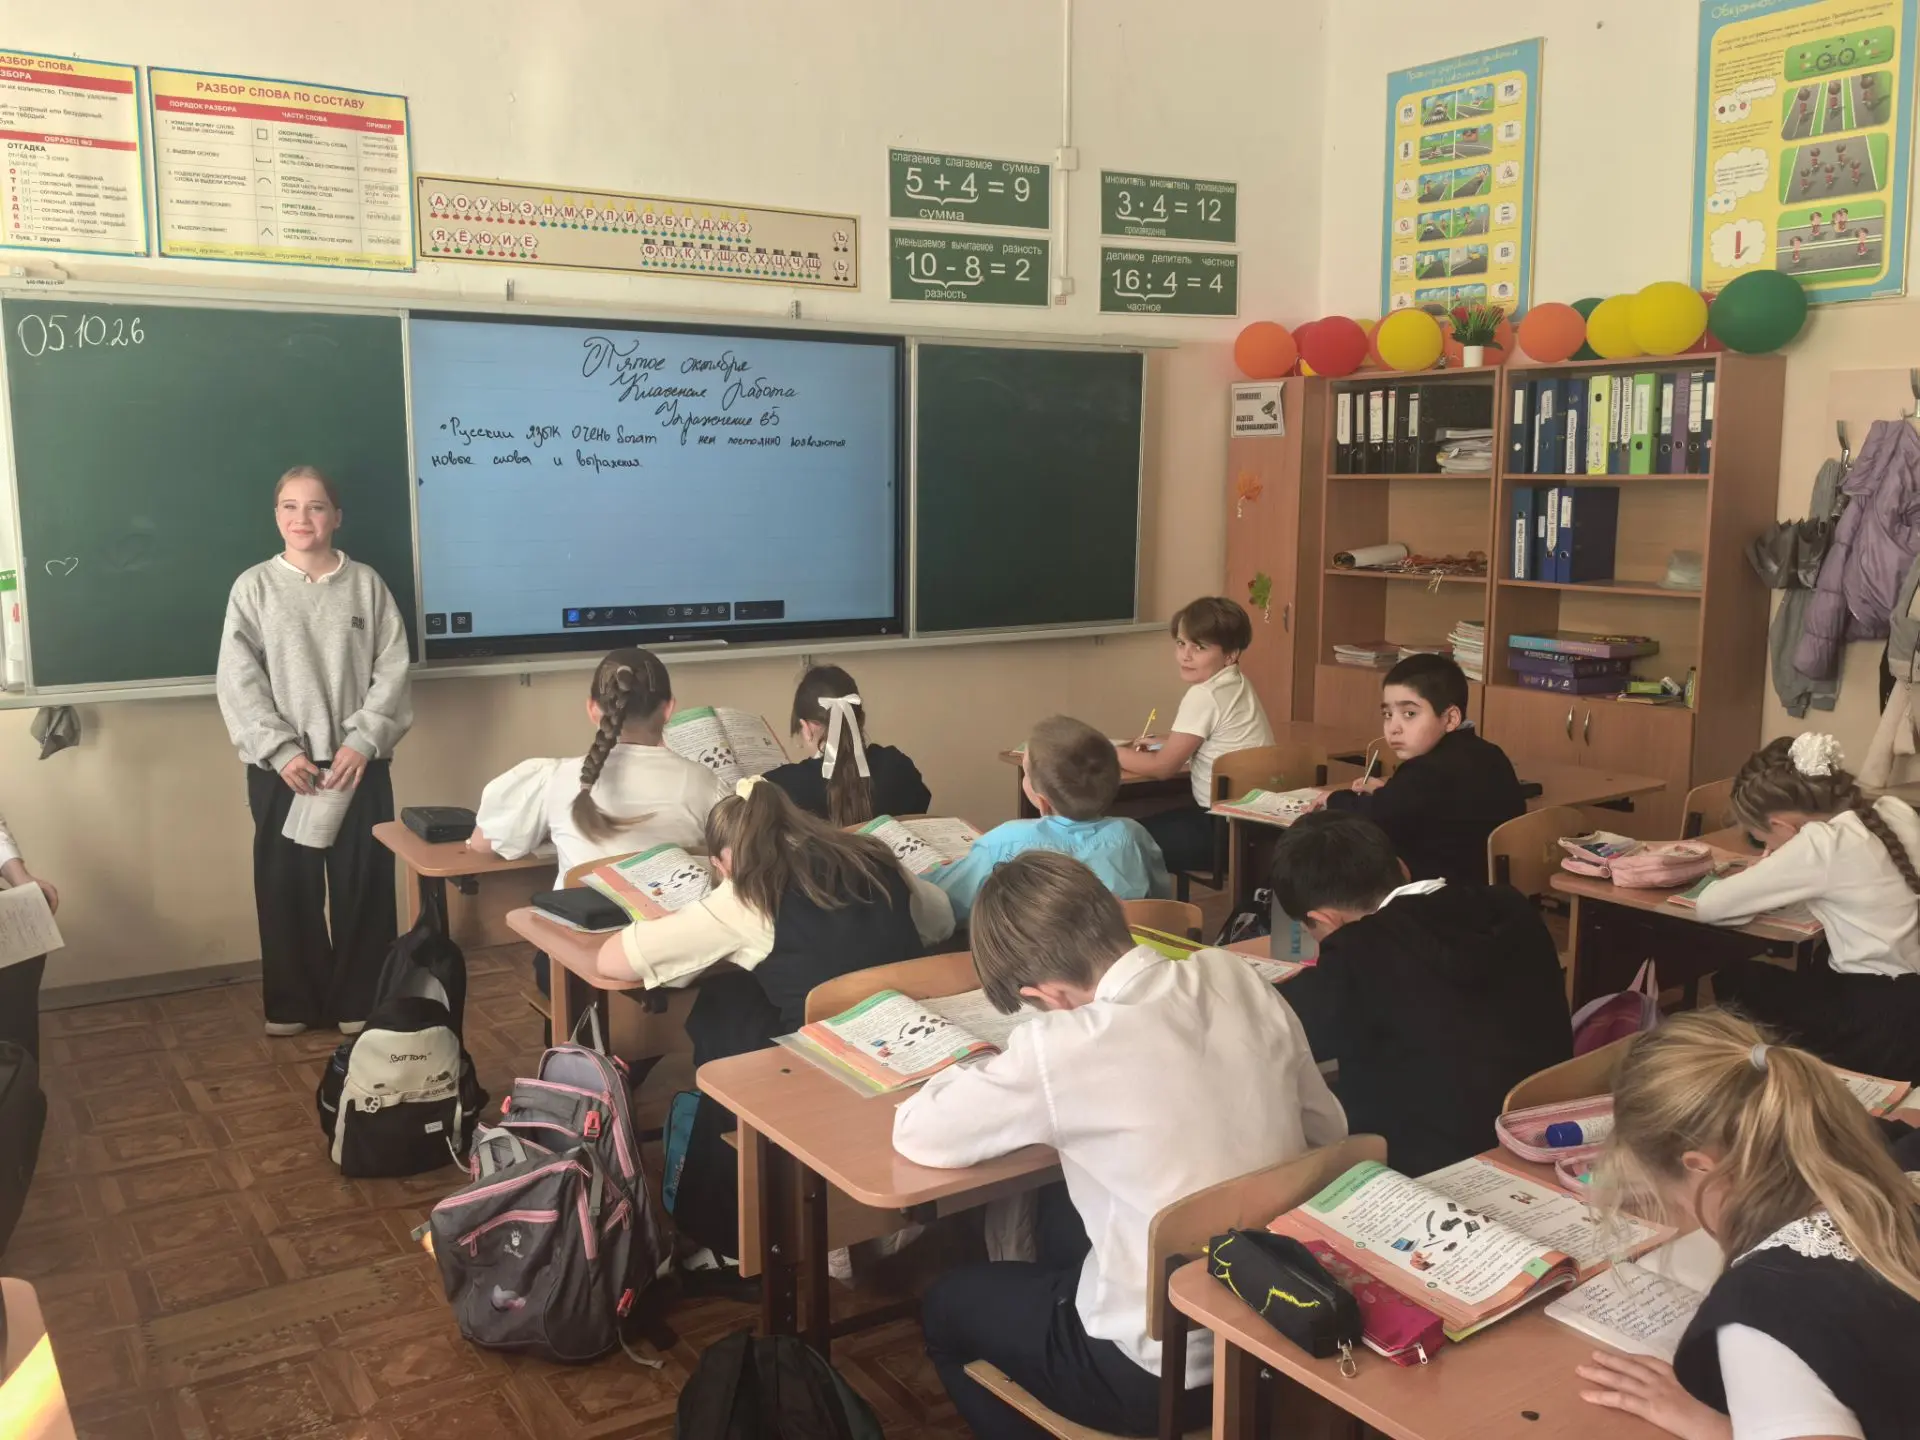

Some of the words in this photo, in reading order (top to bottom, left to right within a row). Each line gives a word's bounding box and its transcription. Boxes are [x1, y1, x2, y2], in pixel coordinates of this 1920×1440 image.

[38, 60, 74, 71] СЛОВА
[196, 81, 246, 97] РАЗБОР
[249, 87, 291, 101] СЛОВА
[294, 91, 310, 102] ПО
[313, 94, 365, 110] СОСТАВУ
[169, 100, 204, 110] ПОРЯДОК
[204, 104, 238, 113] РАЗБОРА
[281, 111, 303, 120] ЧАСТИ
[303, 114, 328, 123] СЛОВА
[366, 121, 392, 131] ПРИМЕР
[8, 142, 46, 152] ОТГАДКА
[892, 152, 942, 167] слагаемое
[946, 159, 993, 171] слагаемое
[1003, 163, 1041, 175] сумма
[906, 167, 923, 193] 5
[934, 173, 951, 192] +
[960, 172, 977, 198] 4
[988, 181, 1004, 194] =
[1014, 177, 1030, 202] 9
[1105, 175, 1146, 187] множитель
[1150, 180, 1190, 191] множитель
[435, 195, 445, 206] А
[457, 198, 467, 208] О
[480, 199, 488, 210] У
[501, 201, 512, 212] Ы
[523, 203, 532, 213] Э
[545, 205, 553, 215] Н
[565, 207, 575, 217] М
[586, 210, 594, 221] Р
[626, 210, 634, 222] Й
[646, 214, 653, 224] В
[665, 216, 673, 226] Б
[685, 218, 691, 227] Г
[703, 219, 711, 229] Д
[720, 221, 731, 230] Ж
[740, 222, 747, 232] З
[920, 208, 965, 221] сумма
[1118, 190, 1132, 216] 3
[1152, 194, 1167, 218] 4
[1175, 202, 1188, 213] =
[1197, 197, 1222, 222] 12
[437, 230, 445, 240] Я
[479, 233, 492, 244] Ю
[503, 235, 511, 246] И
[525, 237, 532, 247] Е
[894, 237, 946, 249] уменьшаемое
[951, 241, 994, 252] вычитаемое
[1002, 243, 1043, 255] разность
[645, 245, 655, 255] Ф
[665, 247, 673, 256] П
[685, 249, 692, 258] К
[704, 250, 710, 259] Т
[740, 253, 747, 263] С
[758, 254, 766, 264] Х
[793, 257, 800, 267] Ч
[1106, 251, 1145, 263] делимое
[1152, 254, 1193, 265] делитель
[1201, 257, 1236, 268] частное
[905, 251, 937, 277] 10
[965, 255, 980, 279] 8
[990, 263, 1006, 274] =
[1015, 258, 1030, 282] 2
[1112, 268, 1140, 290] 16
[1163, 271, 1178, 292] 4
[1188, 278, 1202, 288] =
[1209, 273, 1223, 294] 4
[925, 288, 967, 300] разность
[1126, 303, 1162, 312] частное
[18, 314, 145, 358] 05.10.26
[582, 336, 666, 378] Пятое
[493, 449, 533, 467] слова
[553, 456, 564, 468] и
